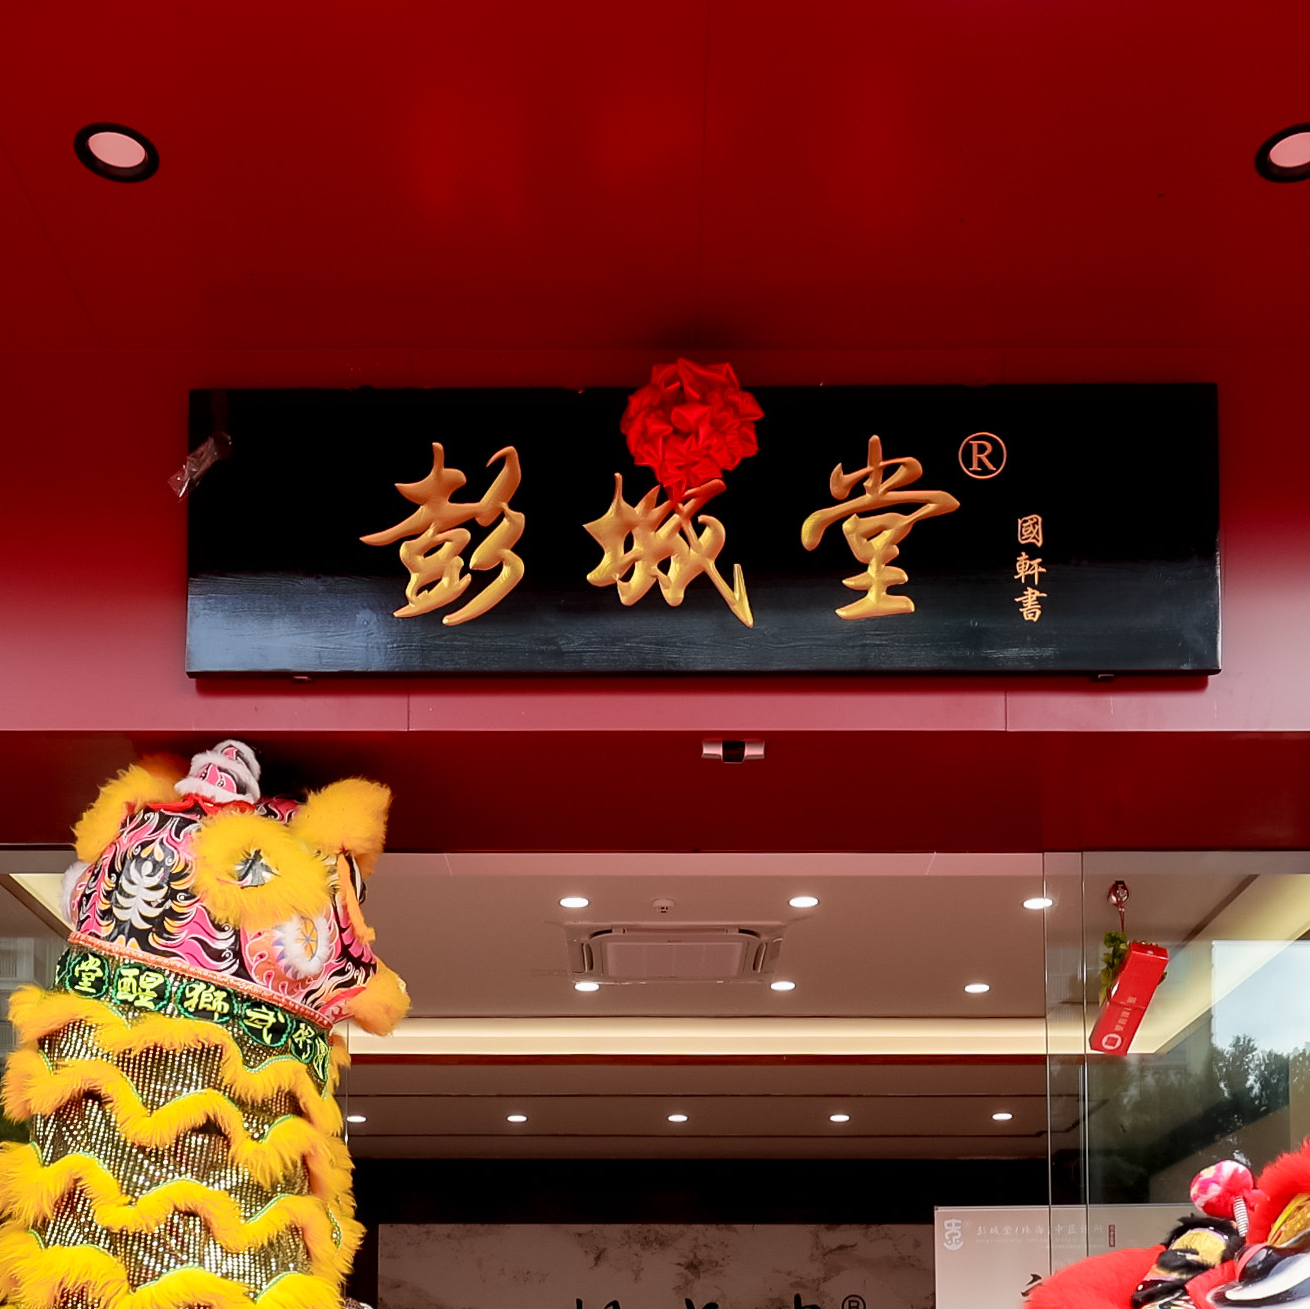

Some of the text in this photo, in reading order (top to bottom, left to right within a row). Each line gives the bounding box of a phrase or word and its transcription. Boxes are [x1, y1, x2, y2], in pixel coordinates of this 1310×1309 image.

[359, 434, 961, 628] 彭城堂
[1013, 513, 1048, 623] 國軒書
